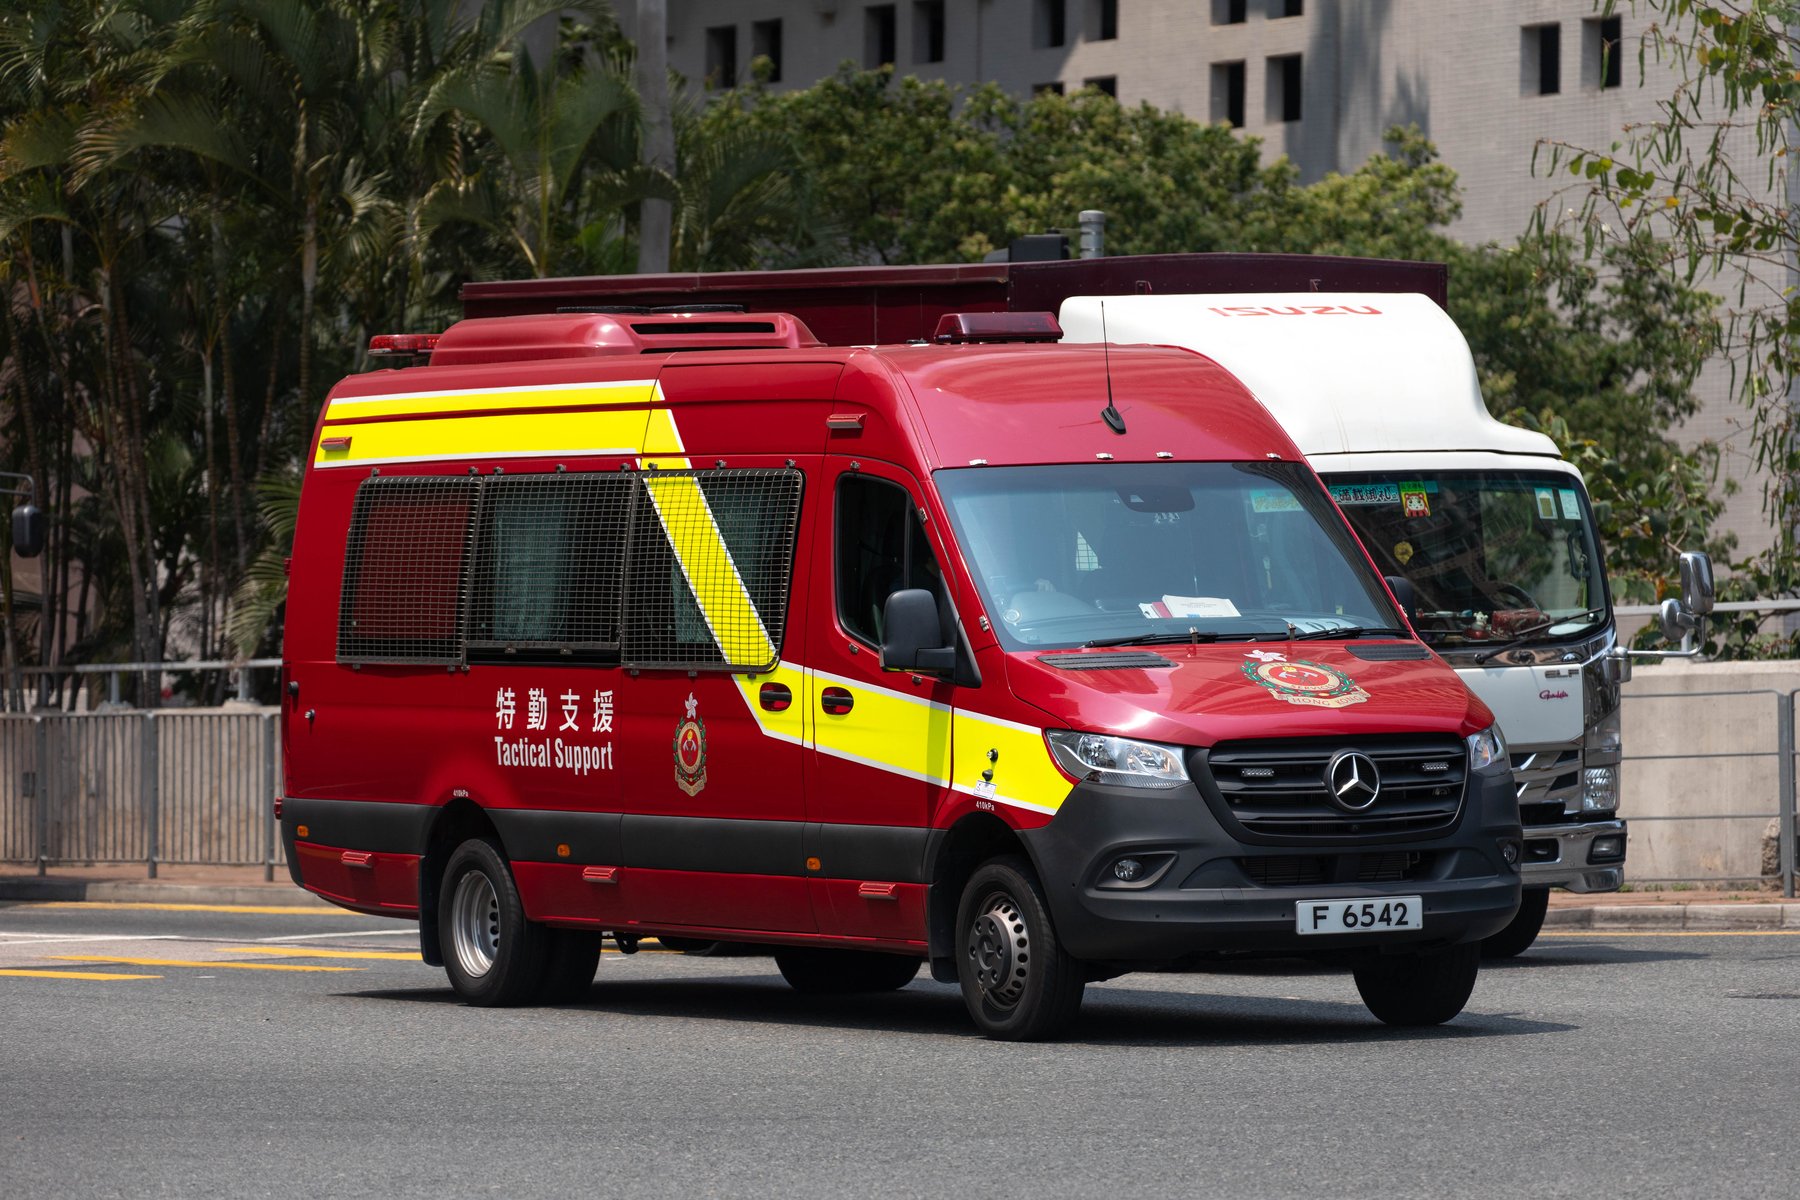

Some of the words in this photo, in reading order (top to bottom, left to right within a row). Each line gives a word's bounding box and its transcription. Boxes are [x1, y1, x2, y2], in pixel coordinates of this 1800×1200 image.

[1207, 305, 1383, 317] ISUZU
[1545, 669, 1579, 678] ELF
[1292, 696, 1331, 706] HONG
[496, 687, 614, 732] 特勤支援
[494, 736, 551, 767] Tactical
[555, 738, 613, 776] Support
[975, 801, 995, 811] 410kPa
[1312, 906, 1329, 929] F
[1342, 903, 1409, 928] 6542
